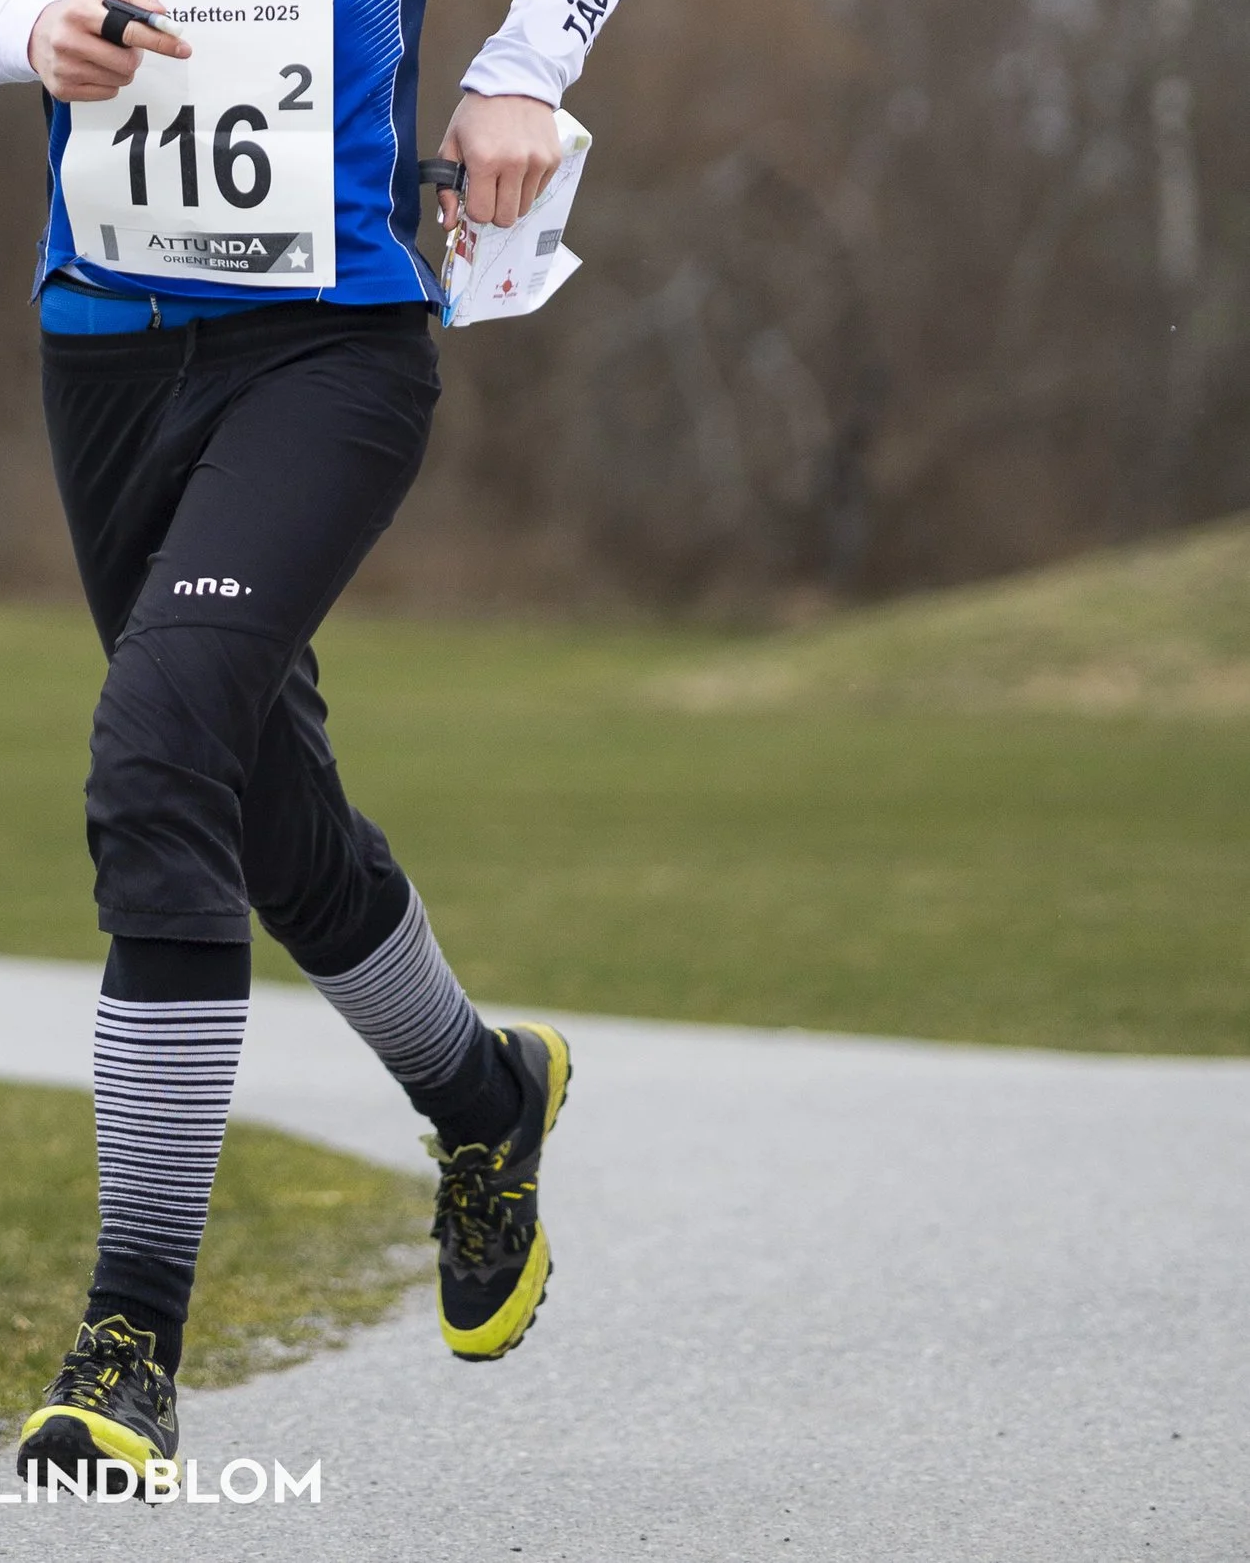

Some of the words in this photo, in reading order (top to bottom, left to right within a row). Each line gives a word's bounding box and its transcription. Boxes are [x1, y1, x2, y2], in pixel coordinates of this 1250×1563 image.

[253, 5, 300, 21] 2025
[278, 63, 314, 111] 2
[111, 104, 272, 209] 116
[163, 255, 249, 269] ORIENTERING
